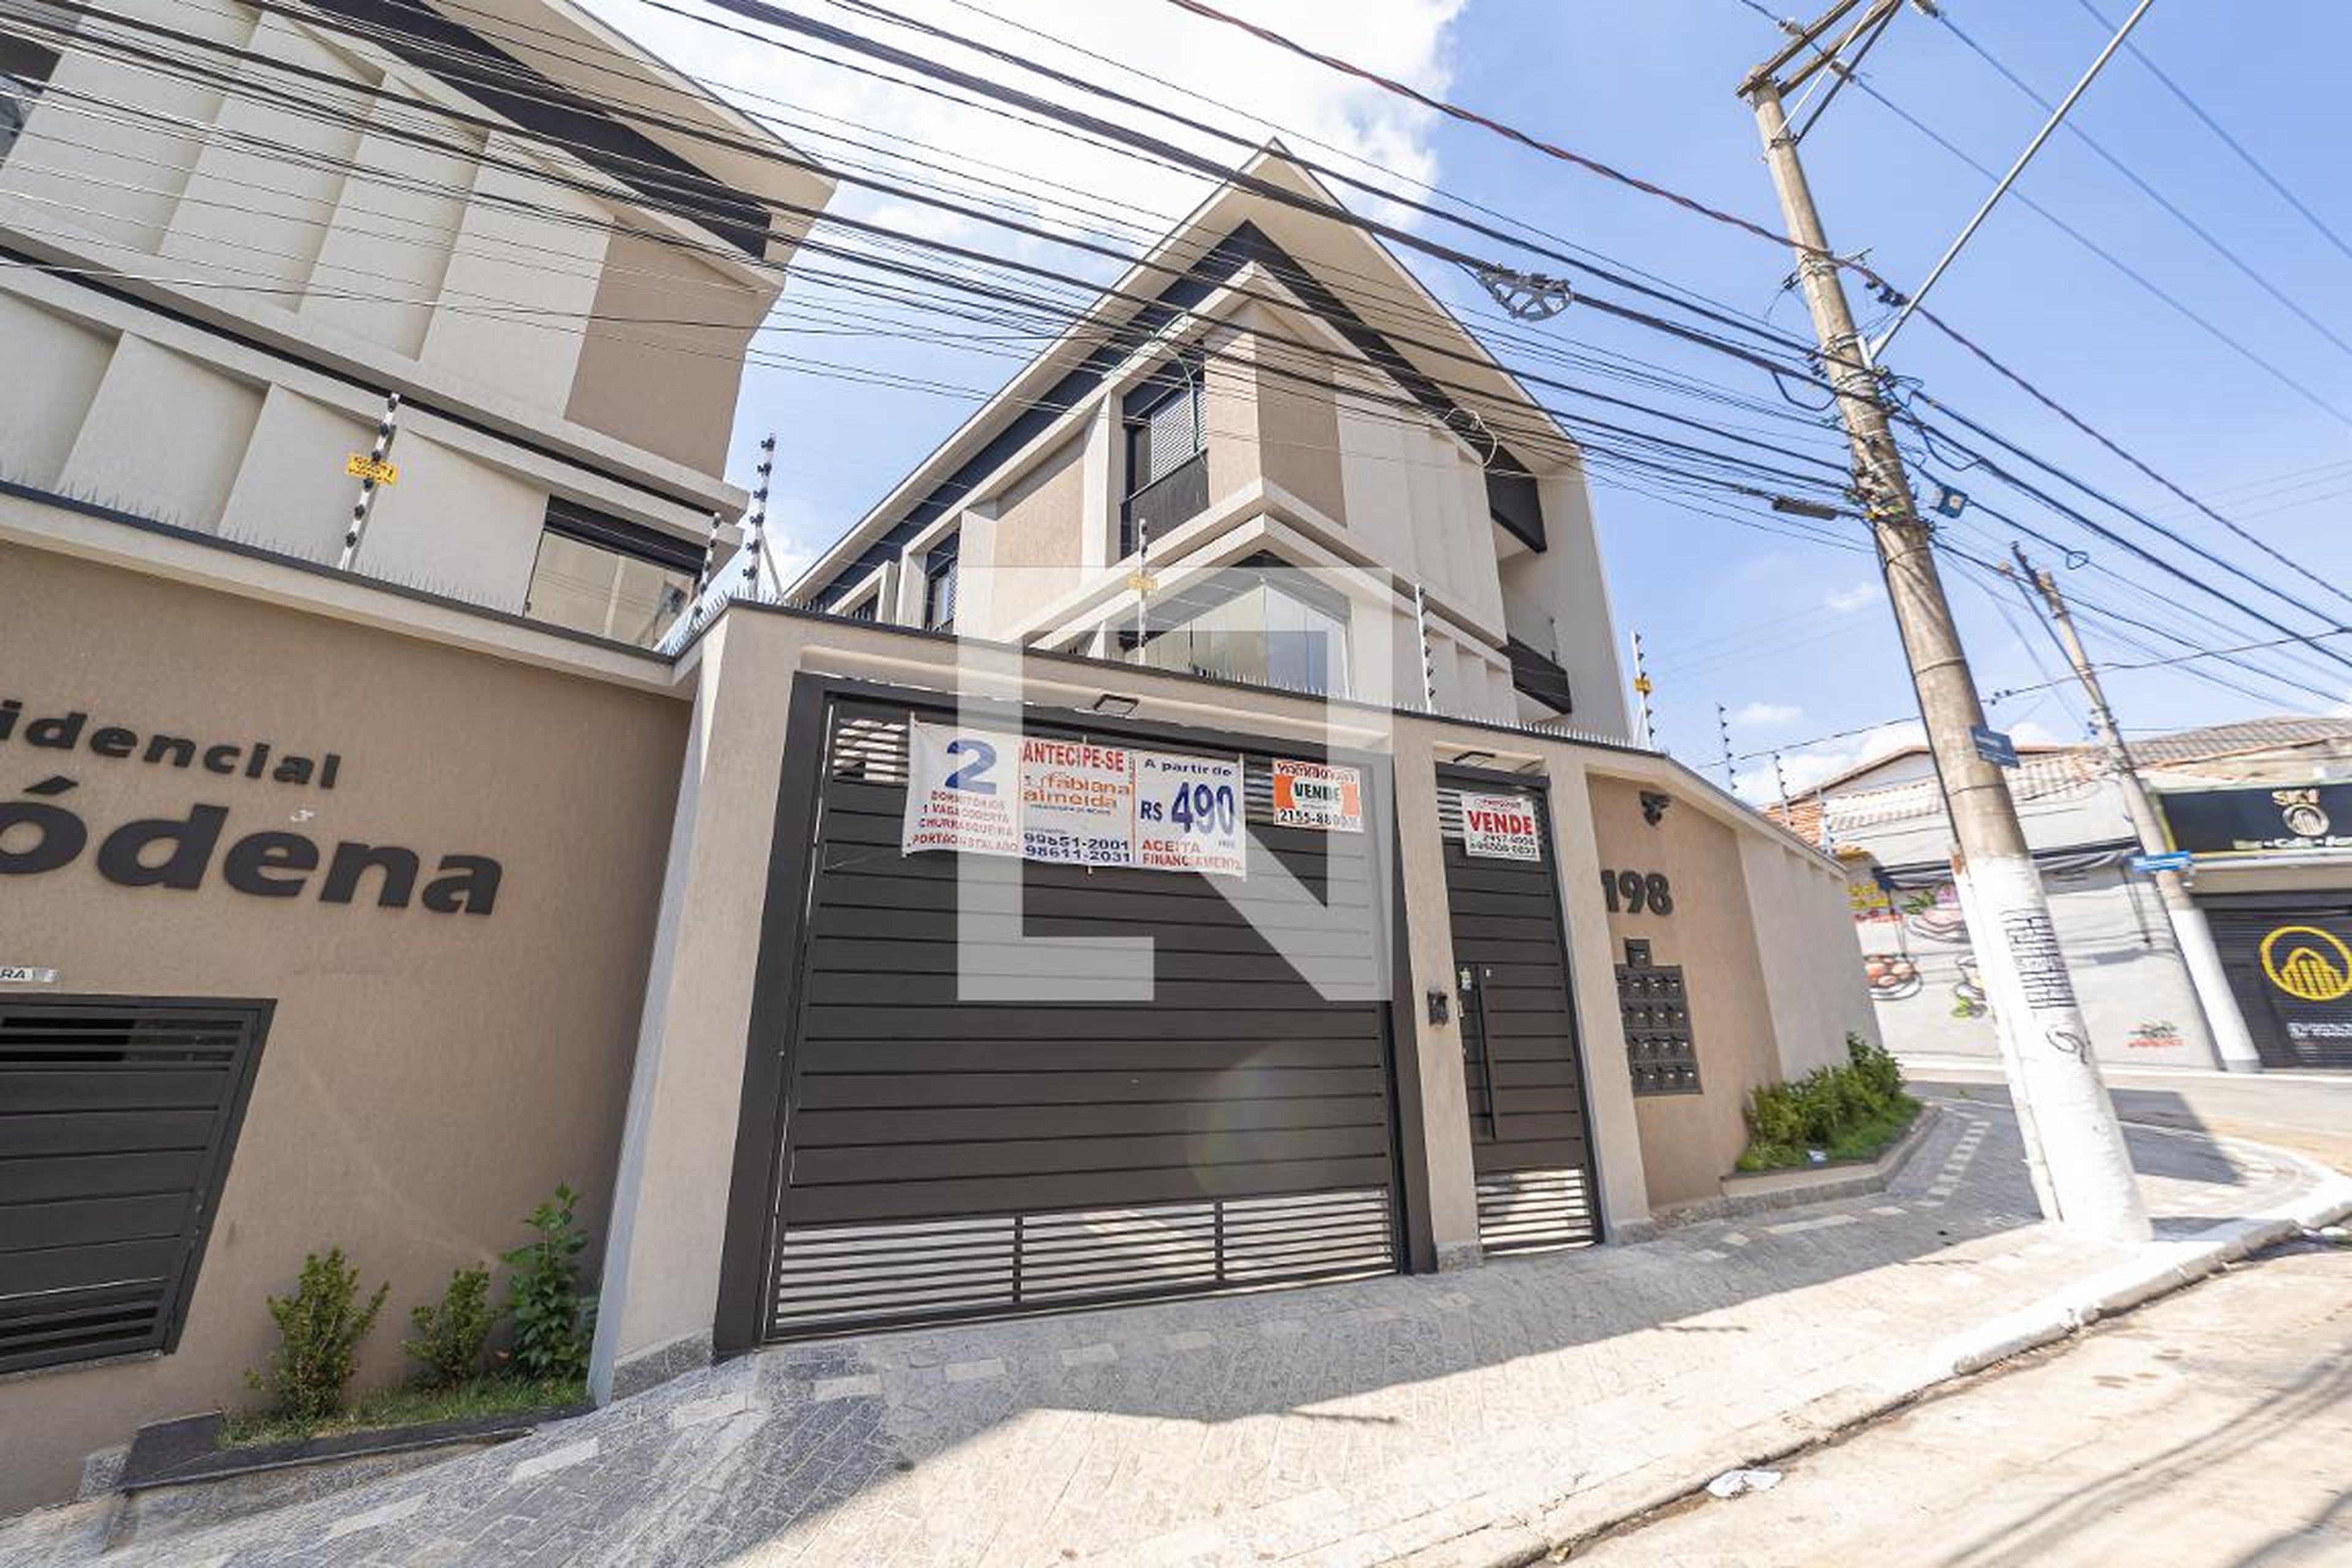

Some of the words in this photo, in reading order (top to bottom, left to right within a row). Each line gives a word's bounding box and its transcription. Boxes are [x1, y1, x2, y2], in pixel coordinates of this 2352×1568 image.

[945, 739, 997, 794] 2
[1023, 741, 1123, 772] ANTECIPE-SE
[1144, 759, 1156, 768] A
[1163, 763, 1210, 774] partir
[1024, 790, 1117, 808] almeida
[1294, 782, 1341, 801] VENDE
[932, 803, 959, 815] VAGA
[1172, 782, 1234, 835] 490
[1467, 810, 1533, 835] VENDE
[1142, 840, 1200, 853] ACEITA
[1600, 869, 1674, 916] 198
